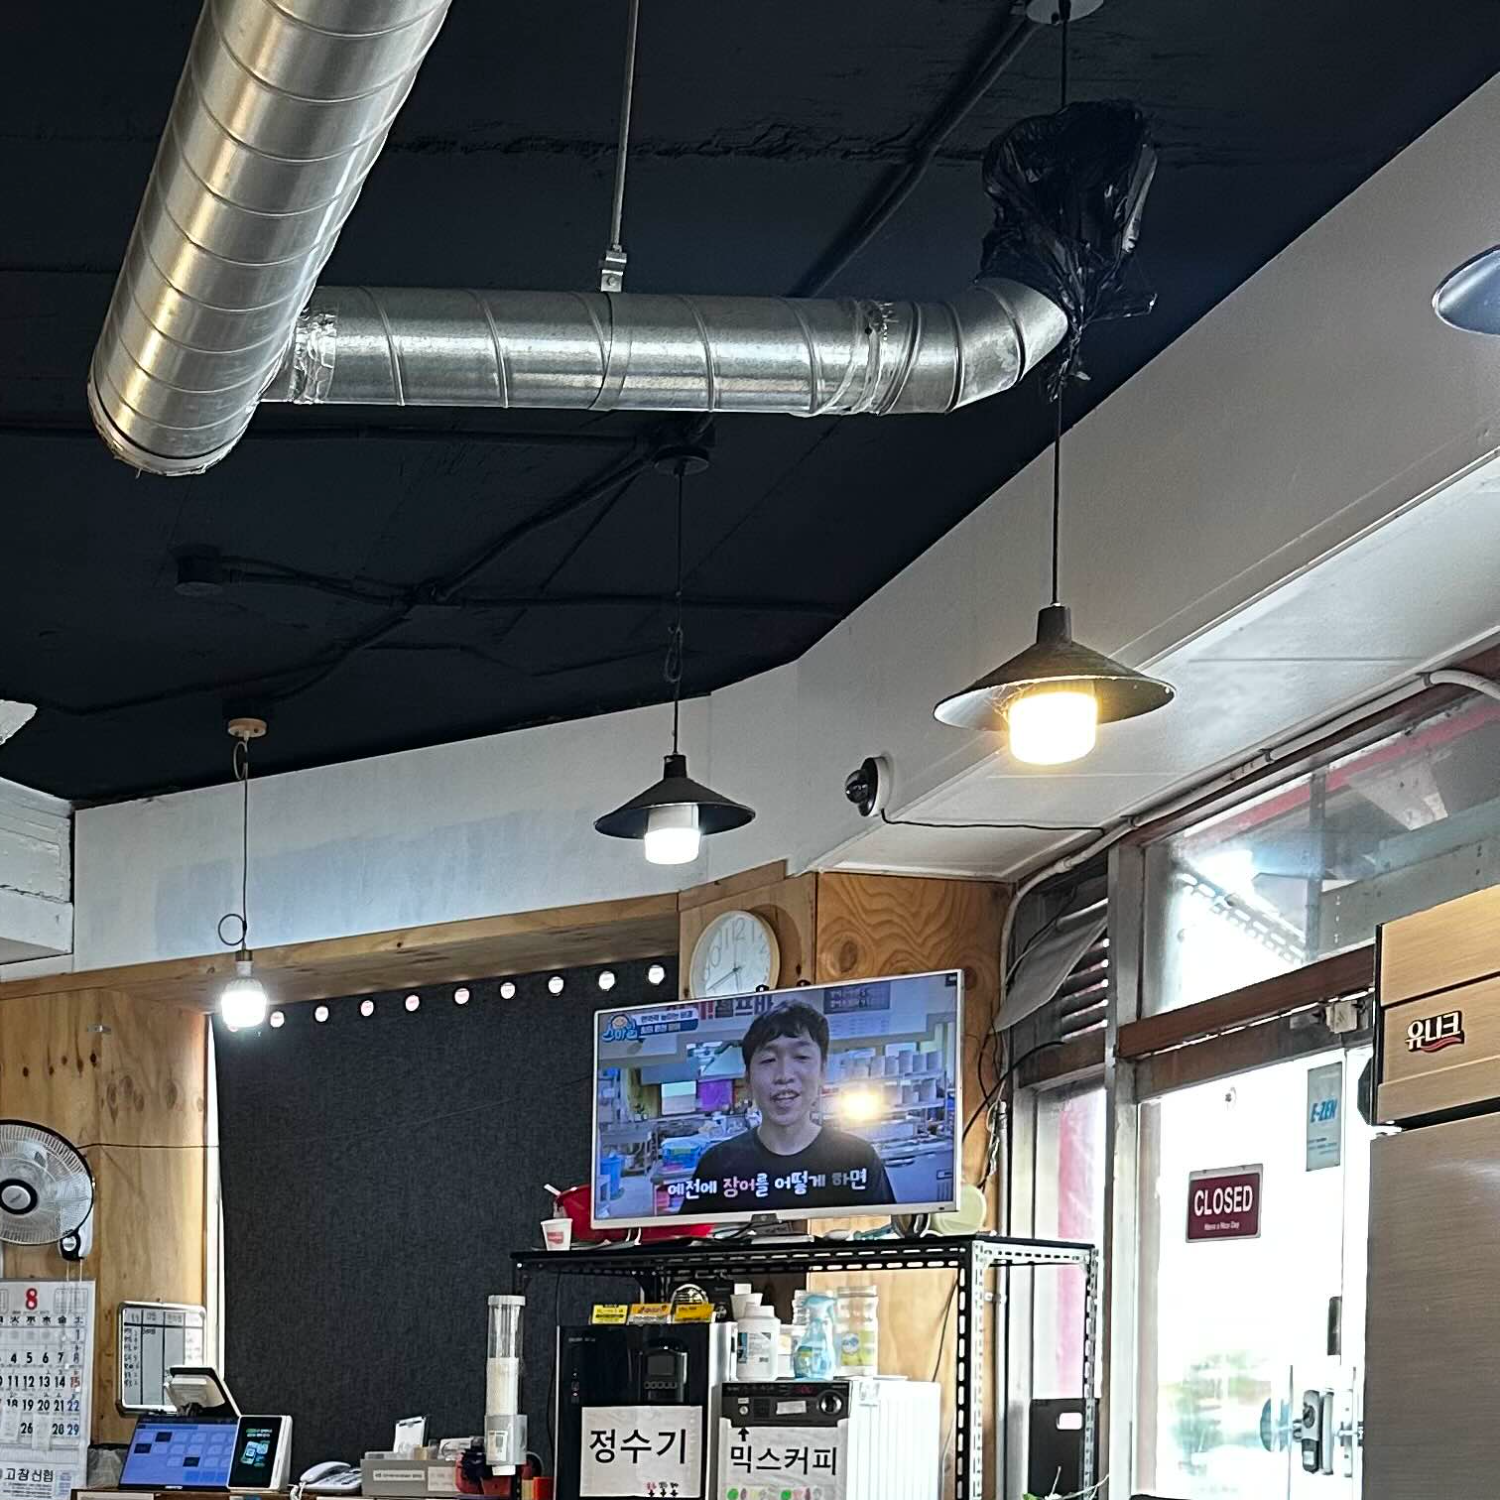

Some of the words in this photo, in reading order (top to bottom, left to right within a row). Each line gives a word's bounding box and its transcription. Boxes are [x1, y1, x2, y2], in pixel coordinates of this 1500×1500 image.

[668, 1179, 717, 1200] 예전에
[723, 1172, 769, 1198] 장어를
[774, 1170, 826, 1195] 어떻게
[831, 1168, 867, 1190] 하면
[1194, 1185, 1253, 1217] CLOSED
[26, 1288, 37, 1310] 8
[10, 1353, 17, 1363] 4
[26, 1352, 33, 1363] 5
[42, 1352, 49, 1363] 6
[58, 1352, 64, 1363] 7
[7, 1375, 19, 1388] 11
[23, 1375, 35, 1388] 12
[39, 1375, 51, 1388] 13
[54, 1375, 66, 1388] 14
[22, 1399, 34, 1411] 19
[37, 1399, 50, 1411] 20
[53, 1399, 65, 1412] 21
[67, 1400, 80, 1411] 22
[20, 1423, 33, 1434] 26
[52, 1423, 65, 1435] 28
[67, 1424, 80, 1435] 29
[588, 1428, 688, 1465] 정수기
[730, 1445, 838, 1475] 믹스커피
